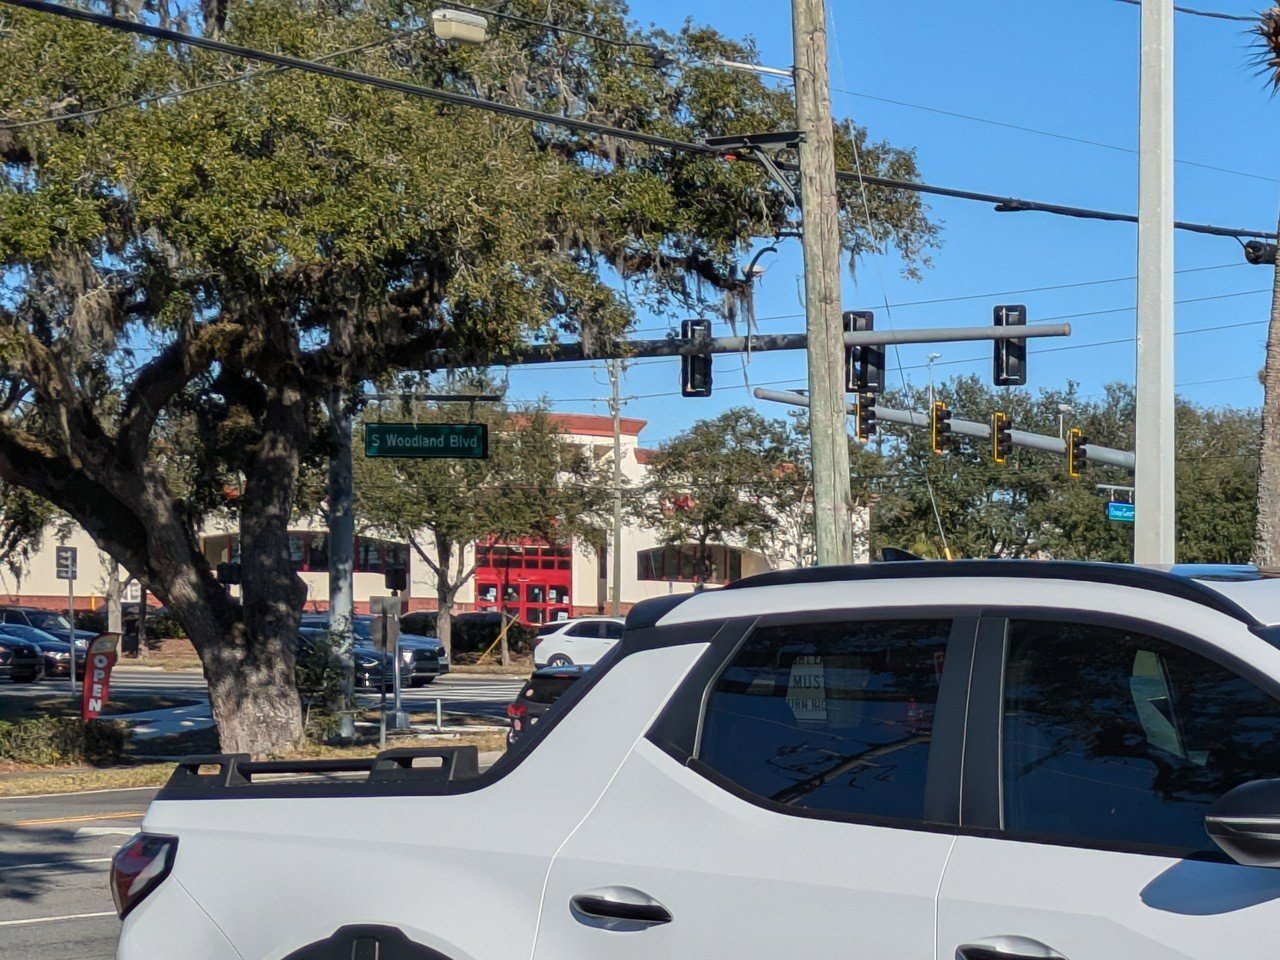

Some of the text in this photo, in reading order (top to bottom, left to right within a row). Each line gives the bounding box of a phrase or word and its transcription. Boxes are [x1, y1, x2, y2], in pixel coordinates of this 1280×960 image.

[371, 433, 478, 448] S Woodland Blvd
[88, 654, 108, 712] OPEN
[794, 674, 823, 689] MUS
